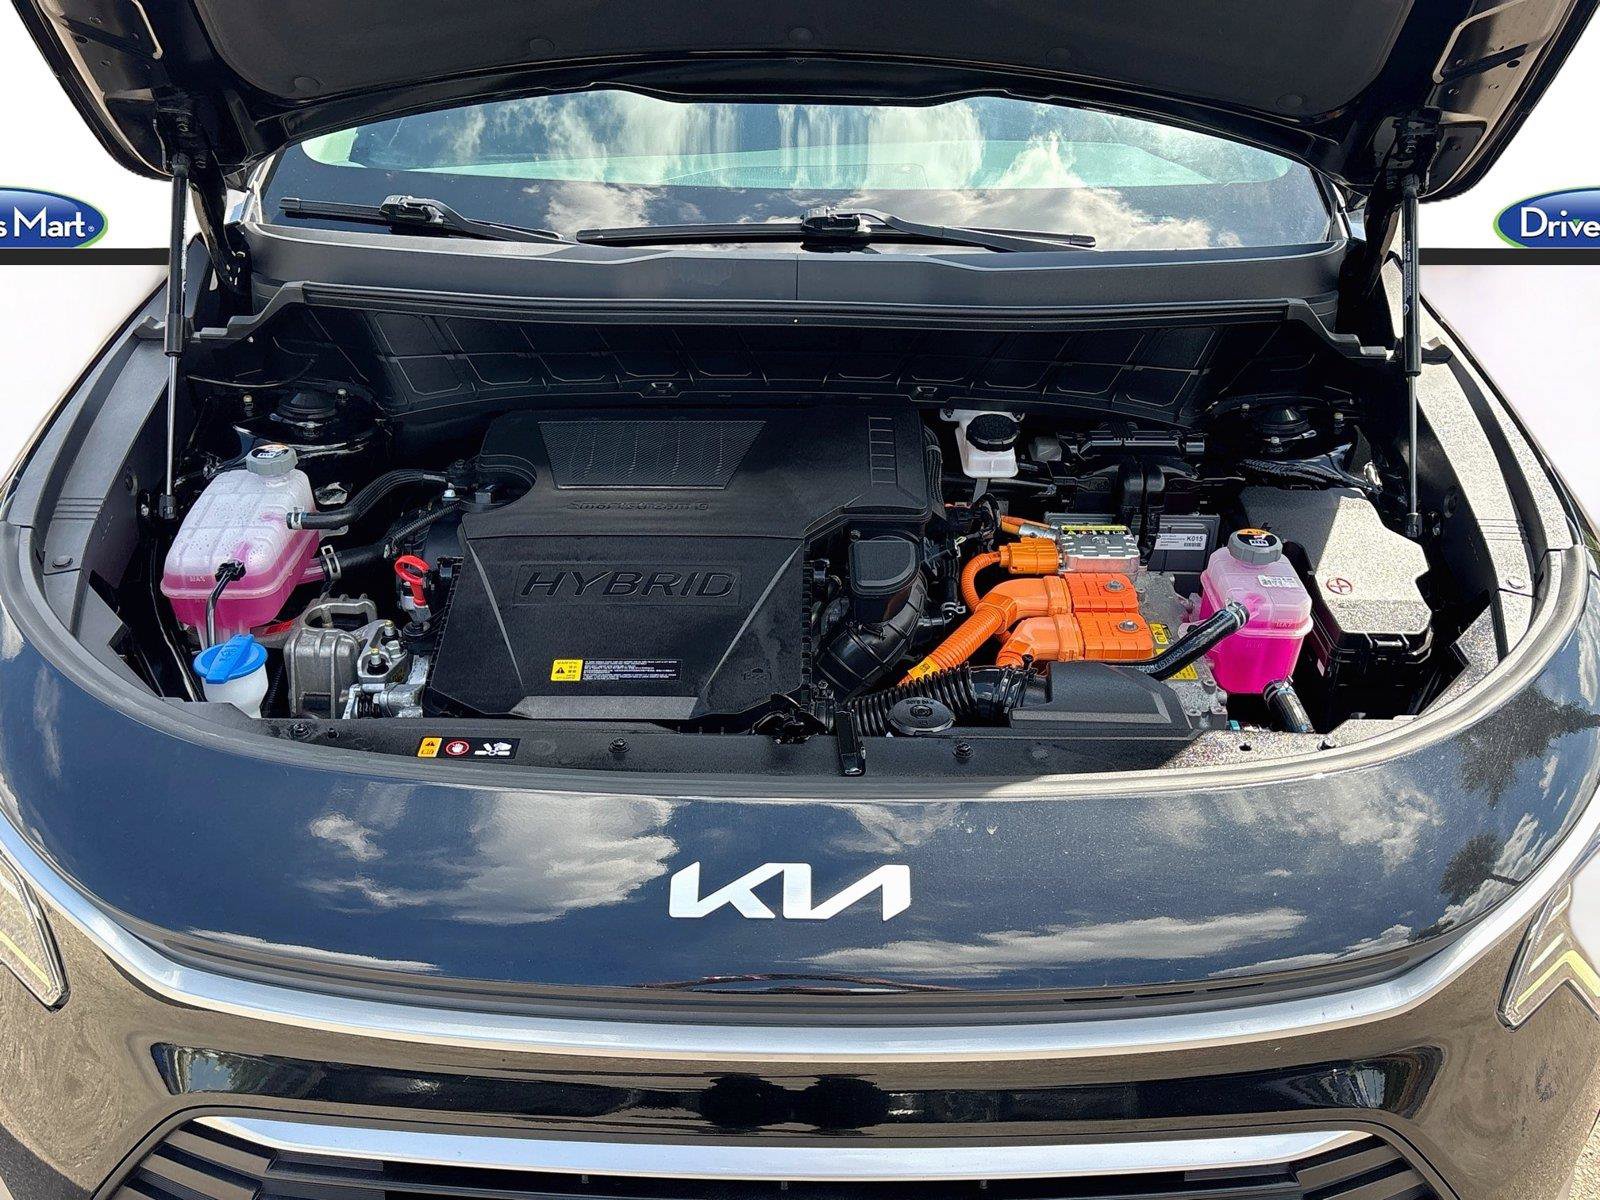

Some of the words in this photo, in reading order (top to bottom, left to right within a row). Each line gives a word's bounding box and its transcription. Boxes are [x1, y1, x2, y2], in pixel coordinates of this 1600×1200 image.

[13, 206, 86, 238] Mart
[1520, 206, 1600, 238] Drive
[520, 571, 737, 597] HYBRID
[669, 861, 911, 922] KIA
